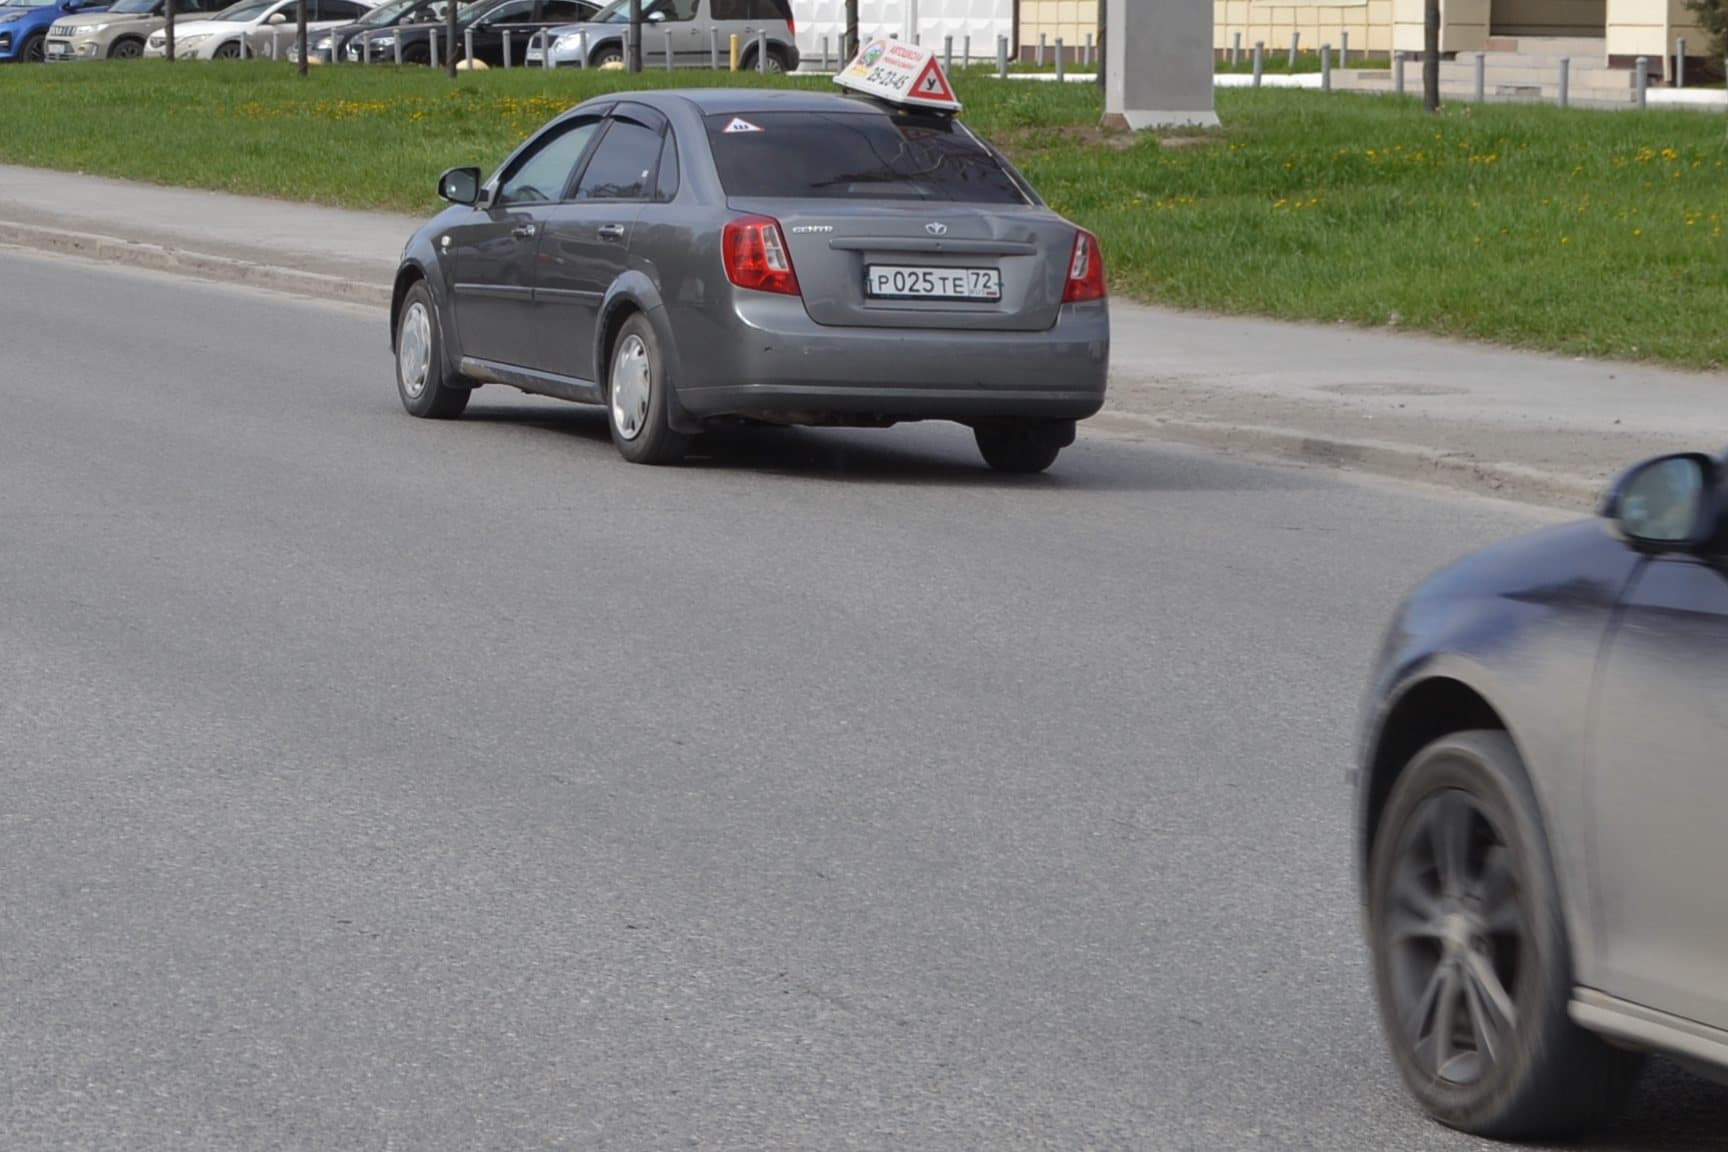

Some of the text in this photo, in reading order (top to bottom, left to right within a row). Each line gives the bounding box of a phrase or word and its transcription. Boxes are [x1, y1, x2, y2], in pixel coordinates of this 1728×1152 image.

[925, 78, 936, 91] У
[878, 270, 992, 294] Р025ТЕ 72
